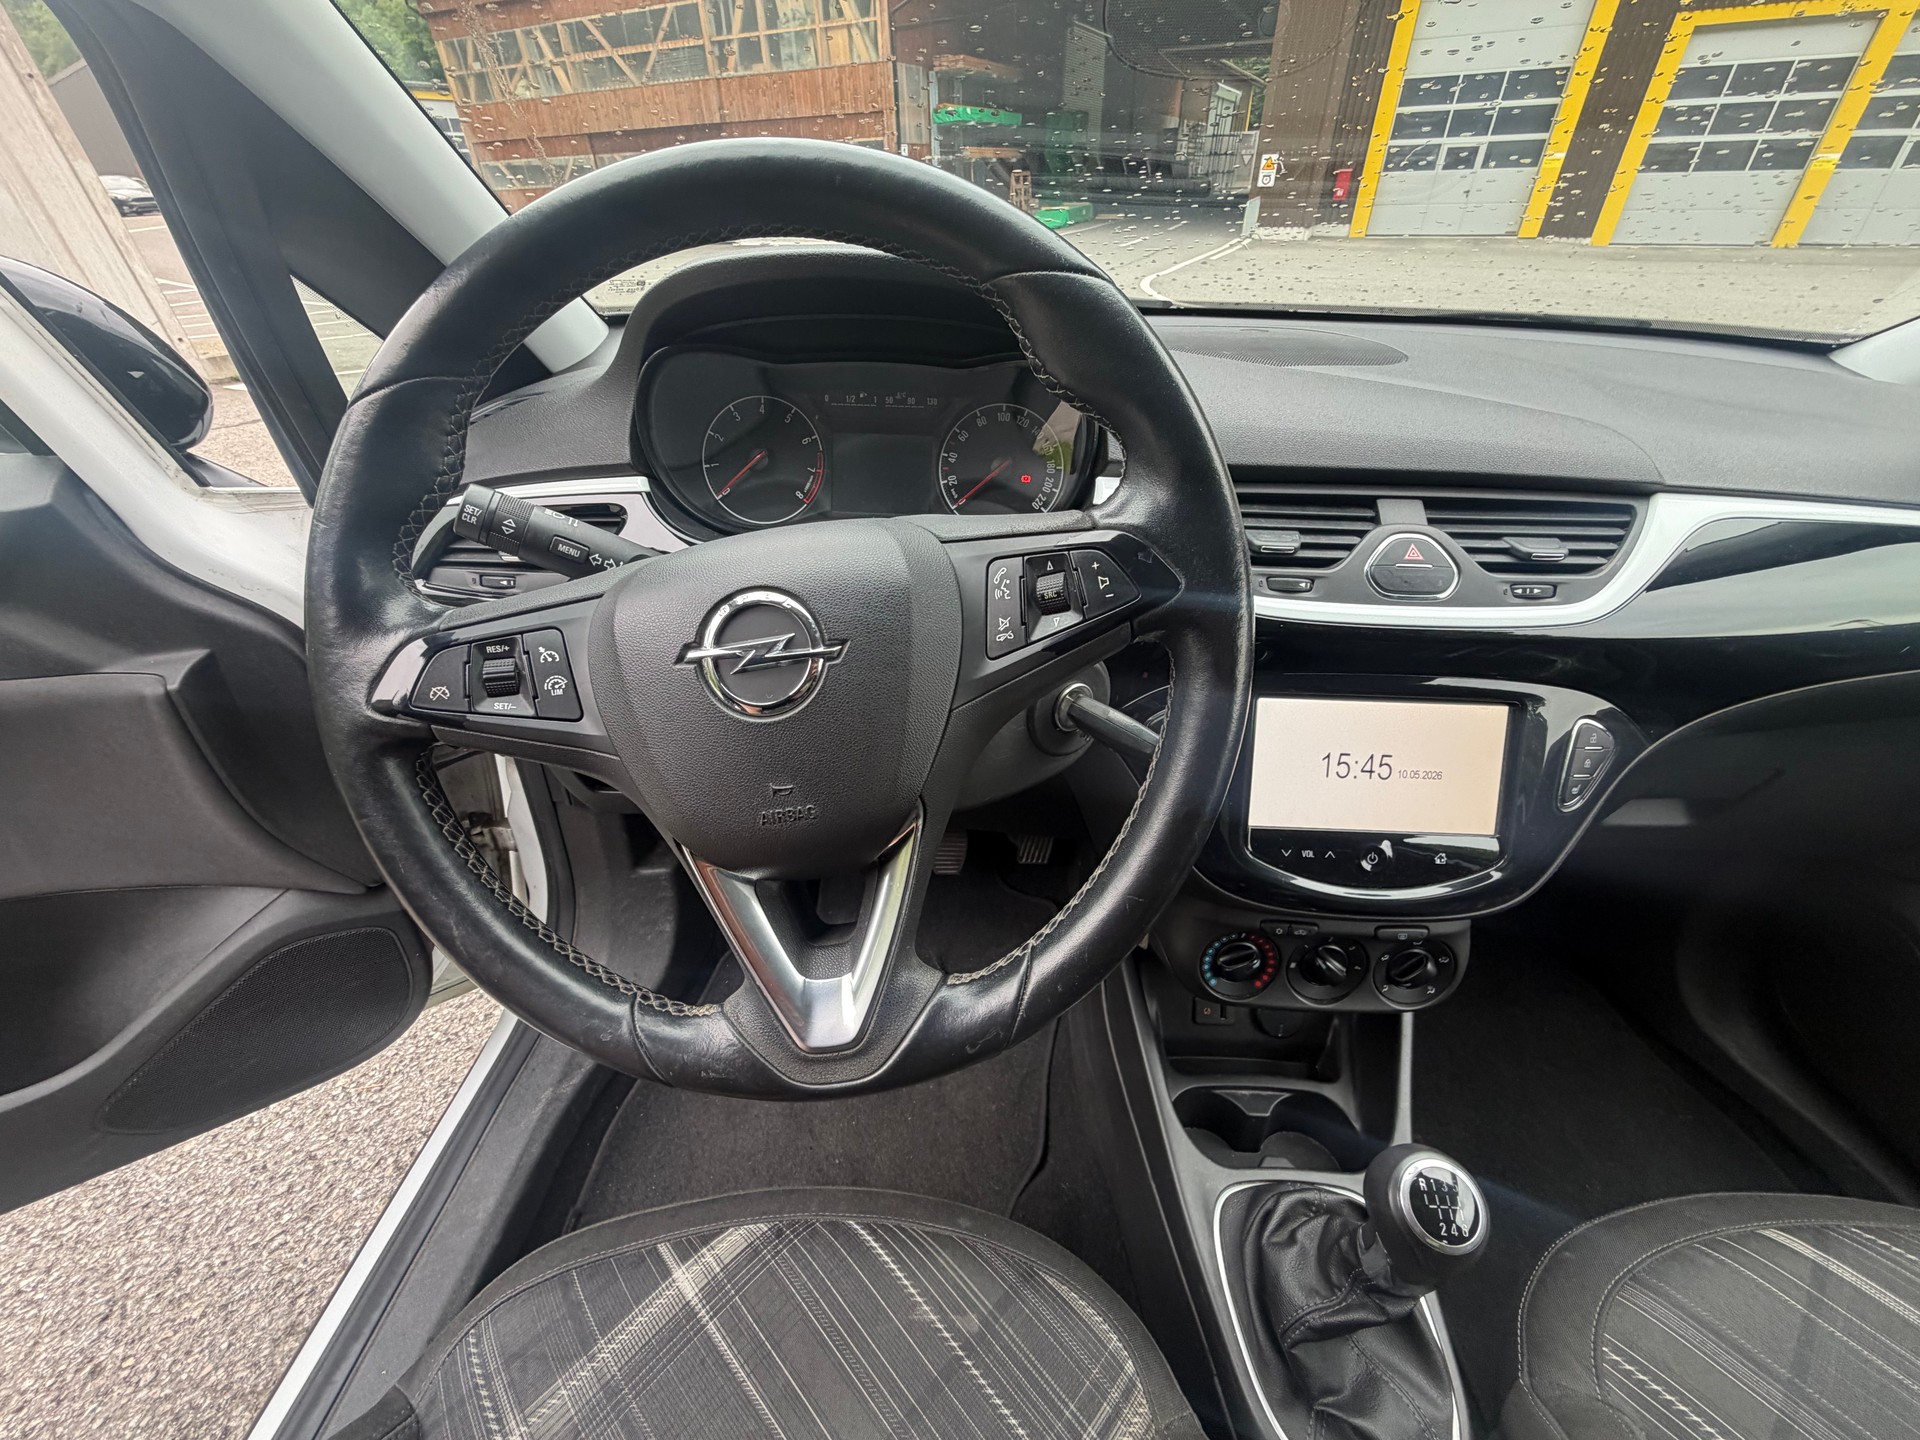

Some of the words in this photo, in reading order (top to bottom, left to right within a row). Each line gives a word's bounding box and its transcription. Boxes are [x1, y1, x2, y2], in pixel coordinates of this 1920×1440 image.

[846, 395, 855, 403] 1/2
[760, 404, 765, 414] 4
[732, 411, 741, 421] 3
[784, 413, 793, 423] 5
[976, 416, 987, 427] 80
[997, 412, 1011, 422] 100
[1017, 415, 1030, 428] 120
[714, 433, 724, 442] 2
[957, 430, 969, 442] 60
[1031, 425, 1045, 440] 140
[801, 437, 812, 445] 6
[947, 452, 958, 464] 40
[1046, 459, 1056, 474] 180
[947, 475, 958, 487] 20
[1042, 477, 1055, 493] 200
[795, 490, 804, 500] 8
[1031, 493, 1047, 510] 220
[463, 504, 483, 517] SET/
[461, 513, 478, 525] CLR
[557, 543, 581, 558] MENU
[1043, 590, 1058, 600] SRC
[485, 645, 510, 654] RES/+
[550, 688, 564, 696] LIM
[1322, 752, 1393, 781] 15:45
[1398, 769, 1443, 781] 10.05.2026
[760, 804, 816, 826] AIRBAG
[1301, 849, 1315, 858] VOL
[1418, 1177, 1428, 1192] R
[1430, 1178, 1436, 1192] 1
[1441, 1180, 1448, 1192] 3
[1439, 1222, 1448, 1236] 2
[1451, 1223, 1459, 1237] 4
[1461, 1223, 1469, 1238] 6
